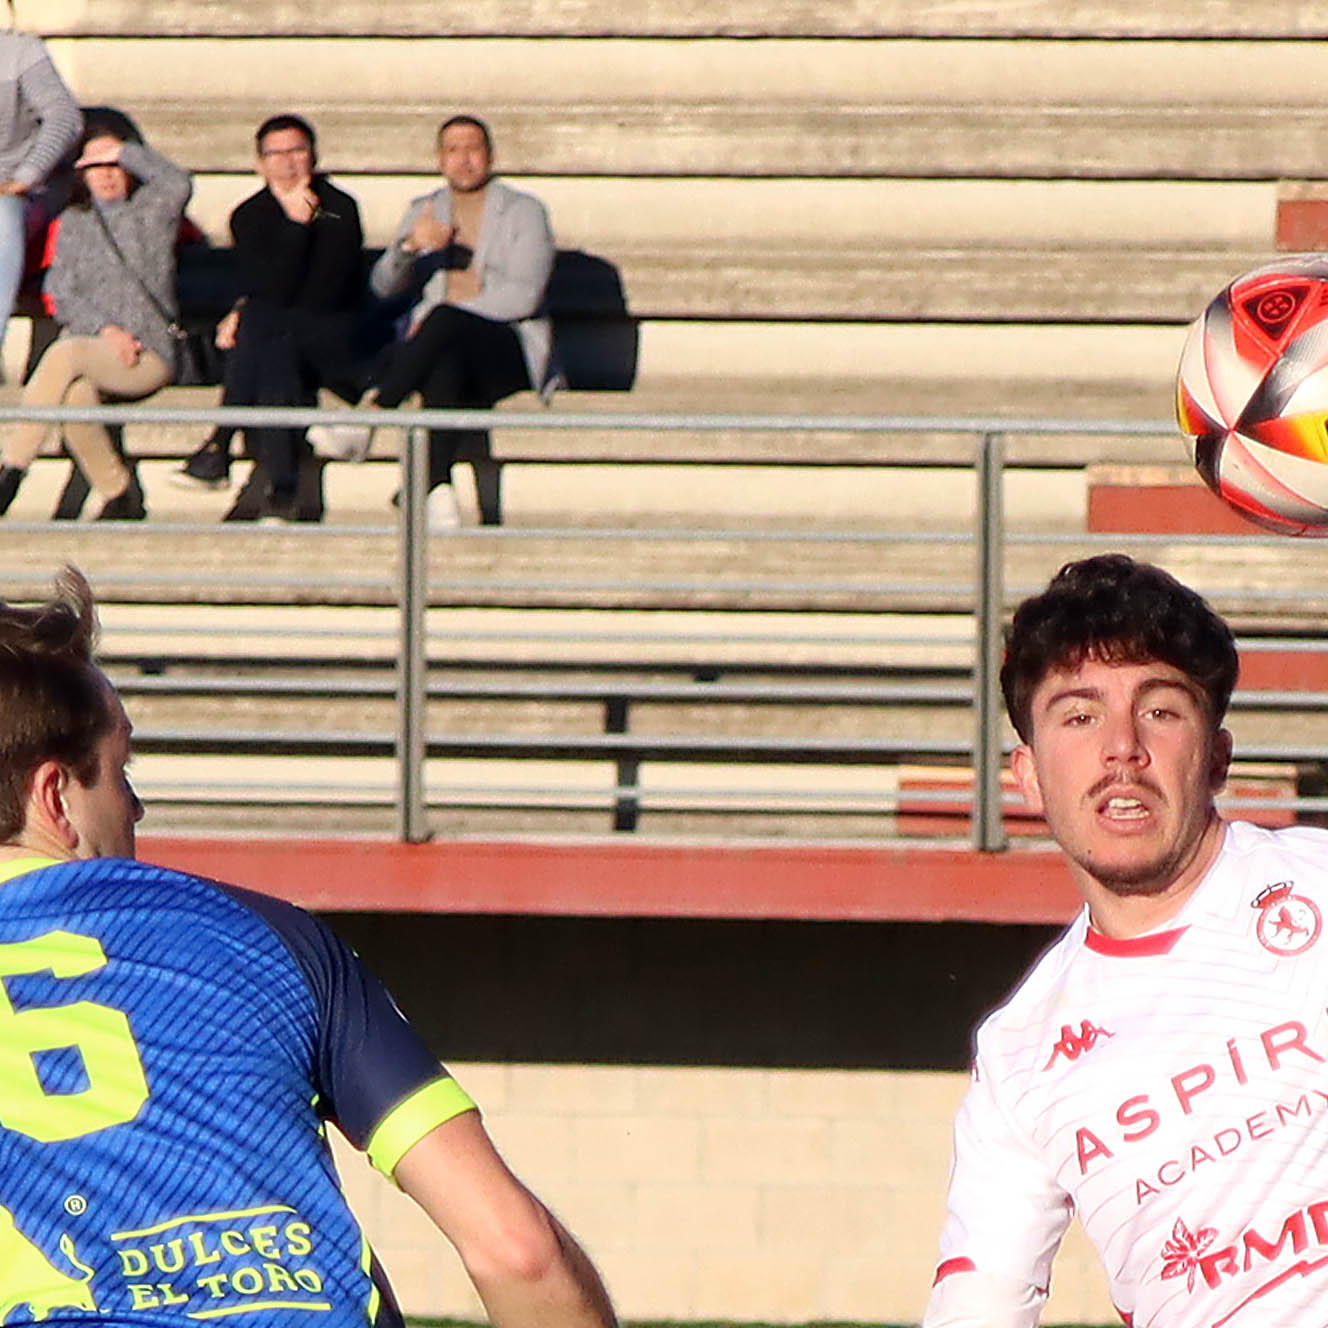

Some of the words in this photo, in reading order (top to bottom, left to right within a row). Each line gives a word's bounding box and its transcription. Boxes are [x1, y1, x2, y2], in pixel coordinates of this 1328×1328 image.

[117, 1221, 313, 1277] DULCES
[126, 1283, 190, 1311] EL
[196, 1262, 324, 1299] TORO
